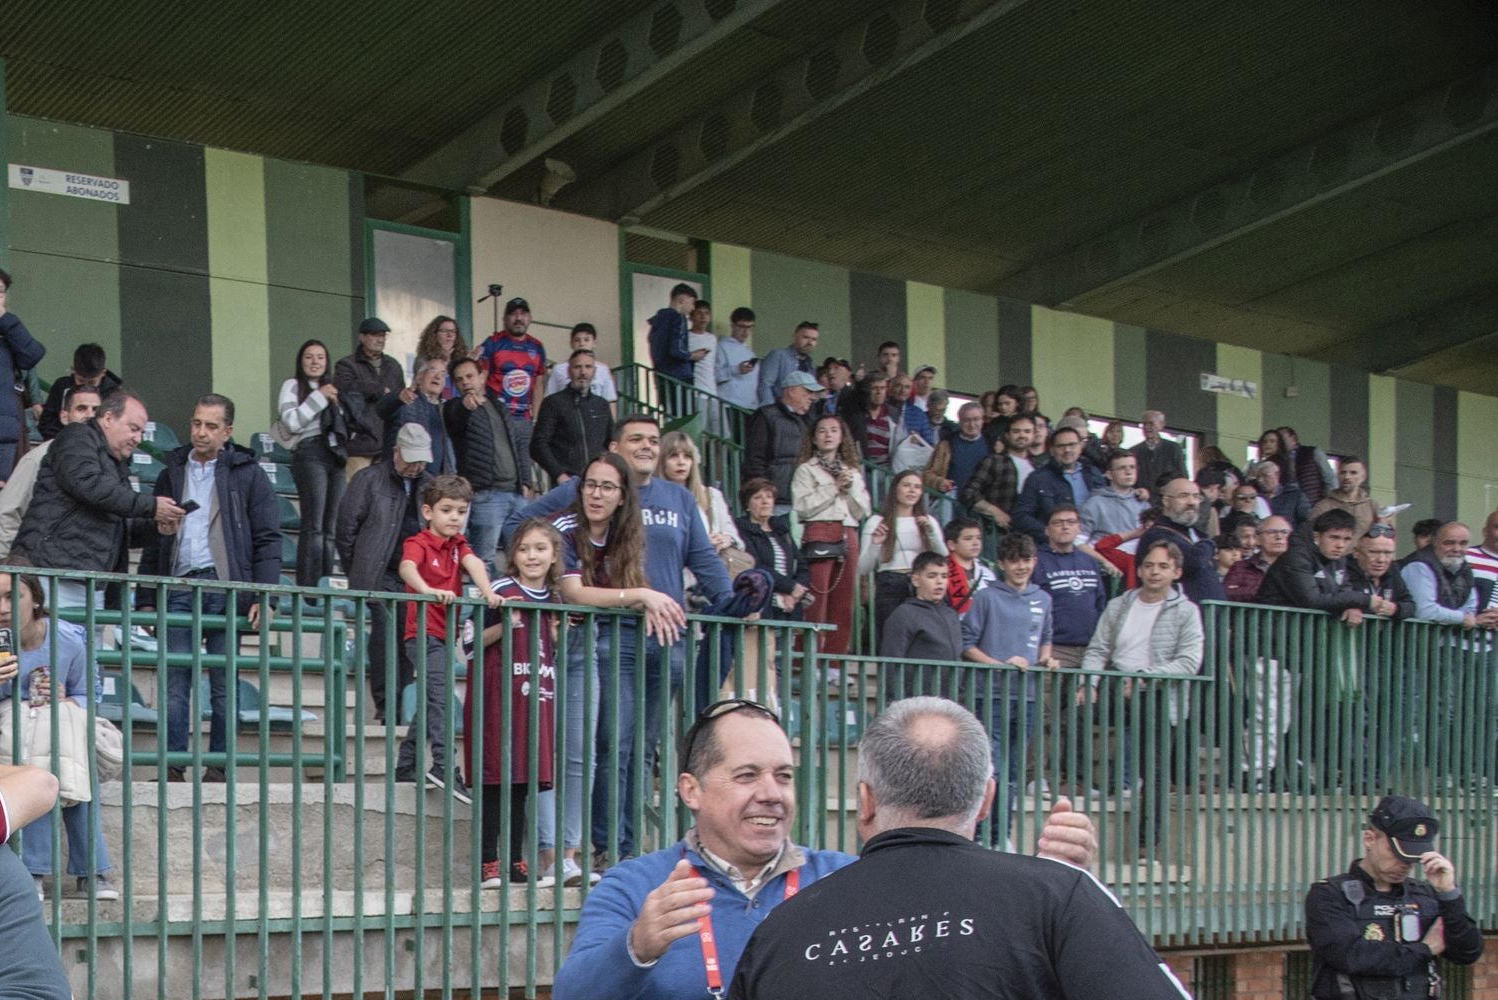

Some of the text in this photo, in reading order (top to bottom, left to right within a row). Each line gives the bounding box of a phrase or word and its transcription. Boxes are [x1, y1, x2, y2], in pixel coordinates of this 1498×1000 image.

[65, 174, 119, 190] RESERVADO
[66, 185, 119, 201] ABONADOS
[804, 918, 975, 961] CASARES
